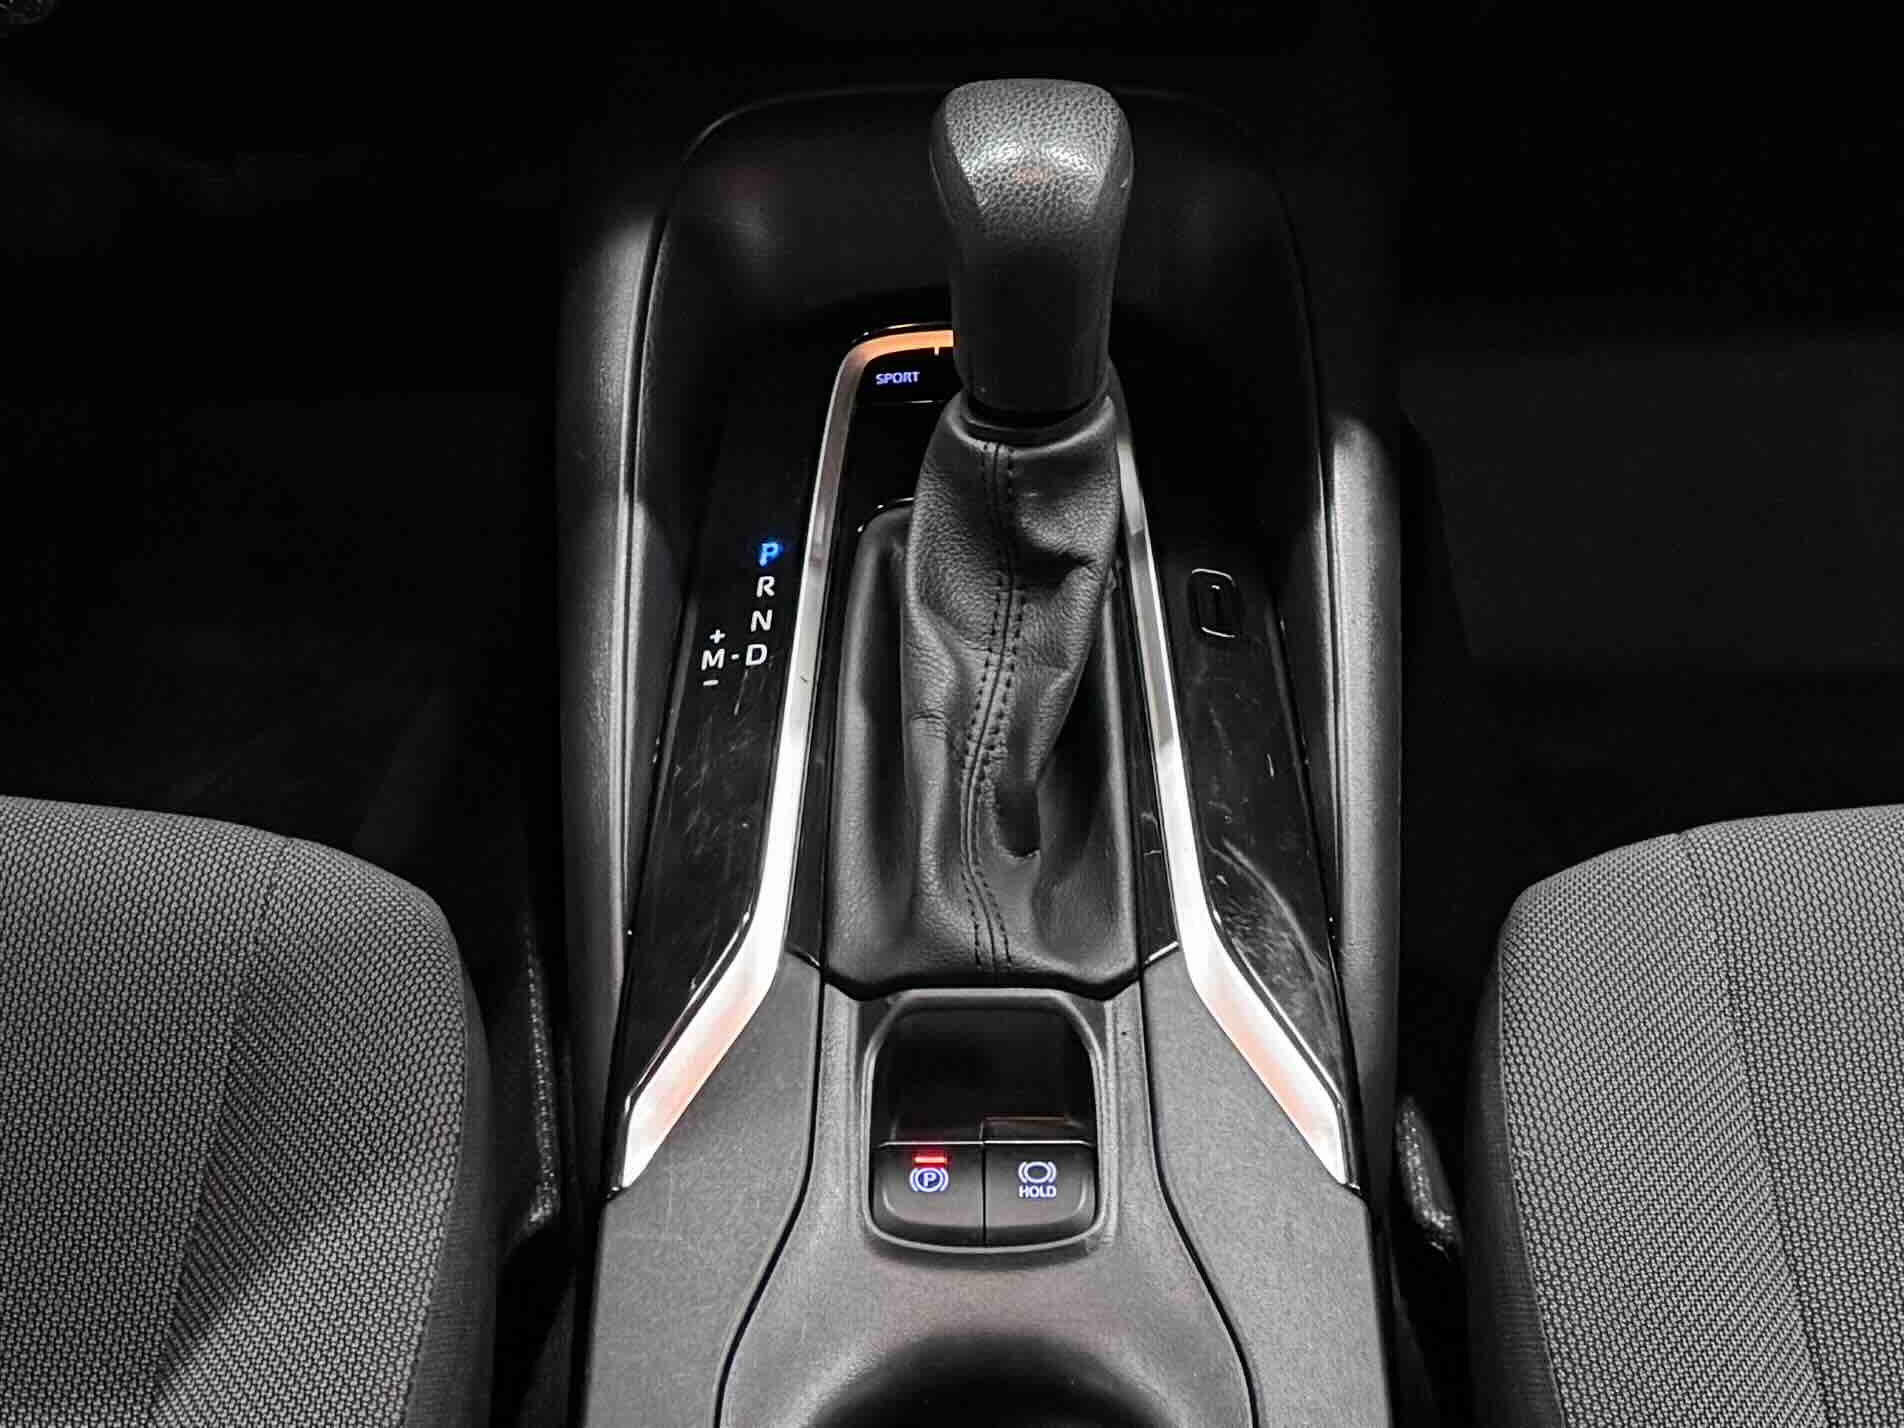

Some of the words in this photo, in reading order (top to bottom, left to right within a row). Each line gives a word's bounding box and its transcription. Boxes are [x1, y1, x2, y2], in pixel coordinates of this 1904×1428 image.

[875, 371, 921, 385] SPORT
[759, 542, 784, 567] P
[756, 575, 776, 598] R
[750, 609, 773, 632] N
[700, 647, 726, 671] M
[744, 643, 769, 667] D
[1018, 1185, 1057, 1198] HOLD
